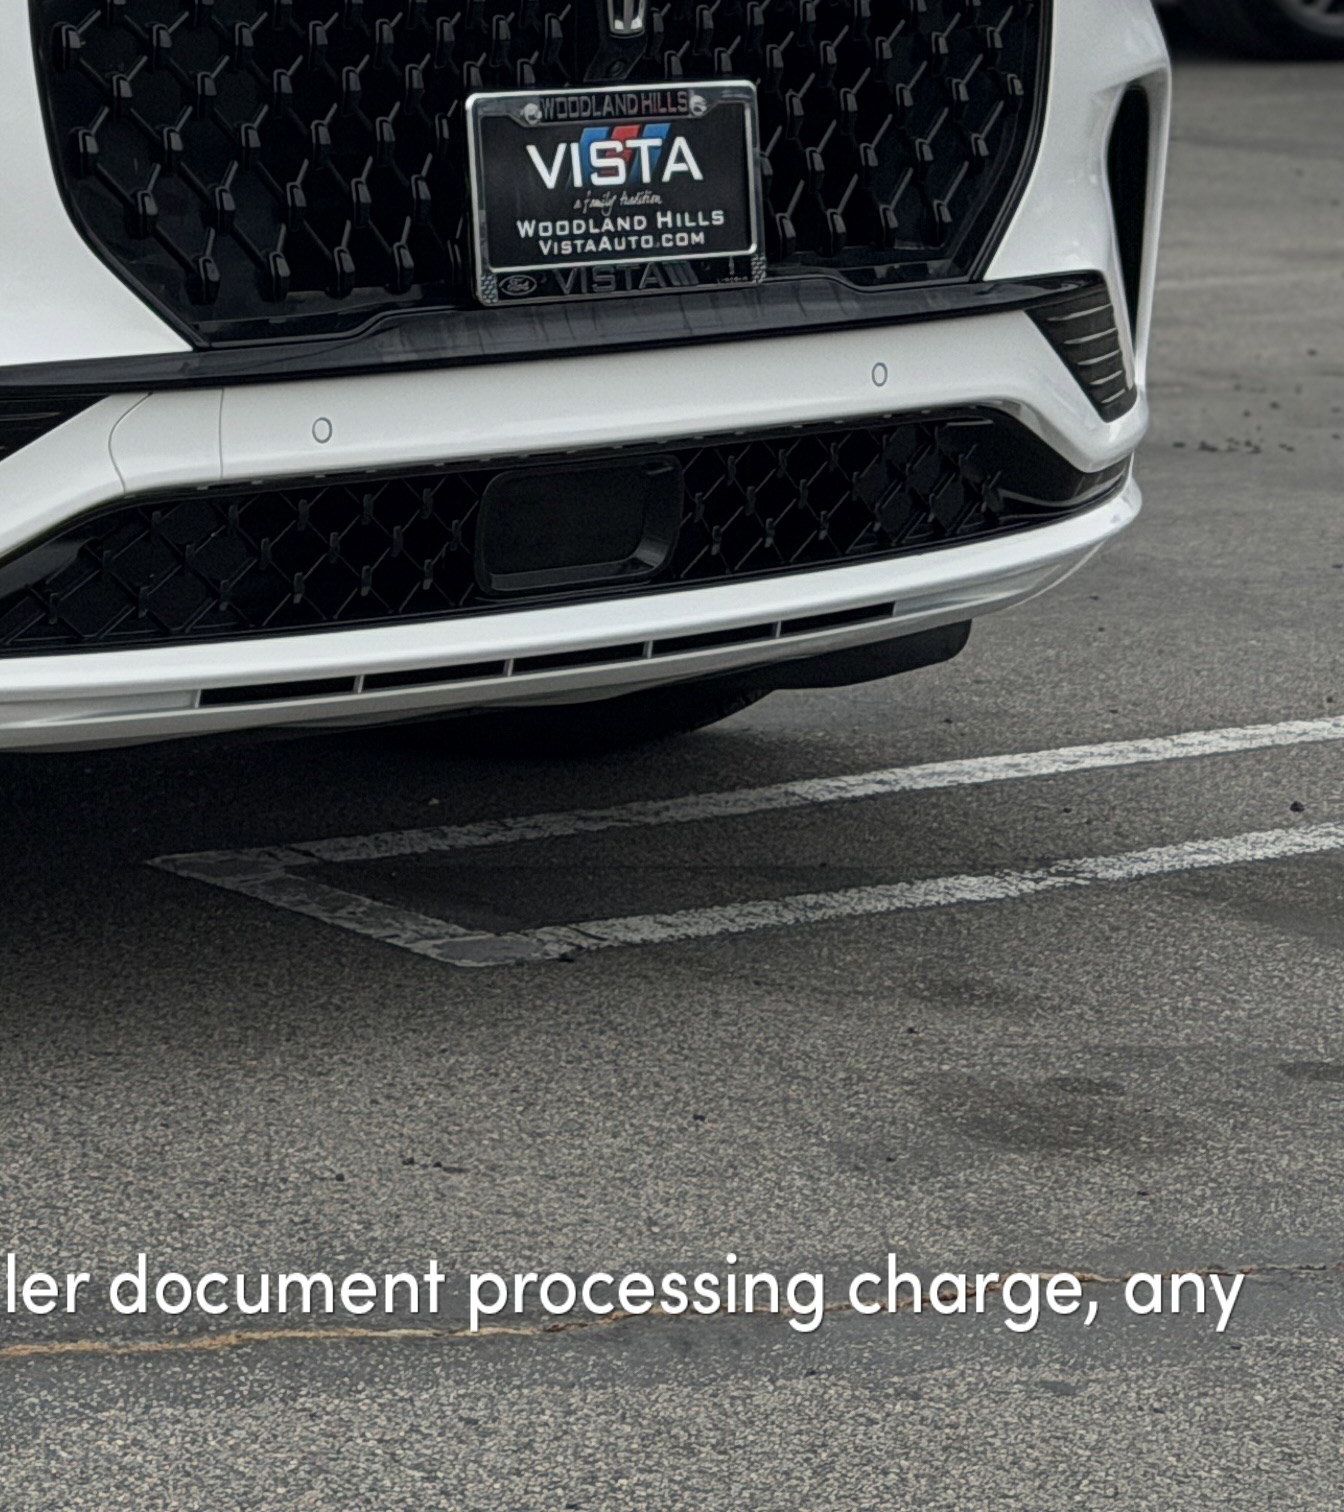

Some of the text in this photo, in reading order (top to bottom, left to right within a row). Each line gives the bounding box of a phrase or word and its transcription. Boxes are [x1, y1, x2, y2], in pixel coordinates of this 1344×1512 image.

[541, 90, 689, 120] WOODLAND HILLS
[525, 136, 704, 190] VISTA
[516, 210, 726, 239] WOODLAND HILLS
[552, 261, 667, 295] VISTA
